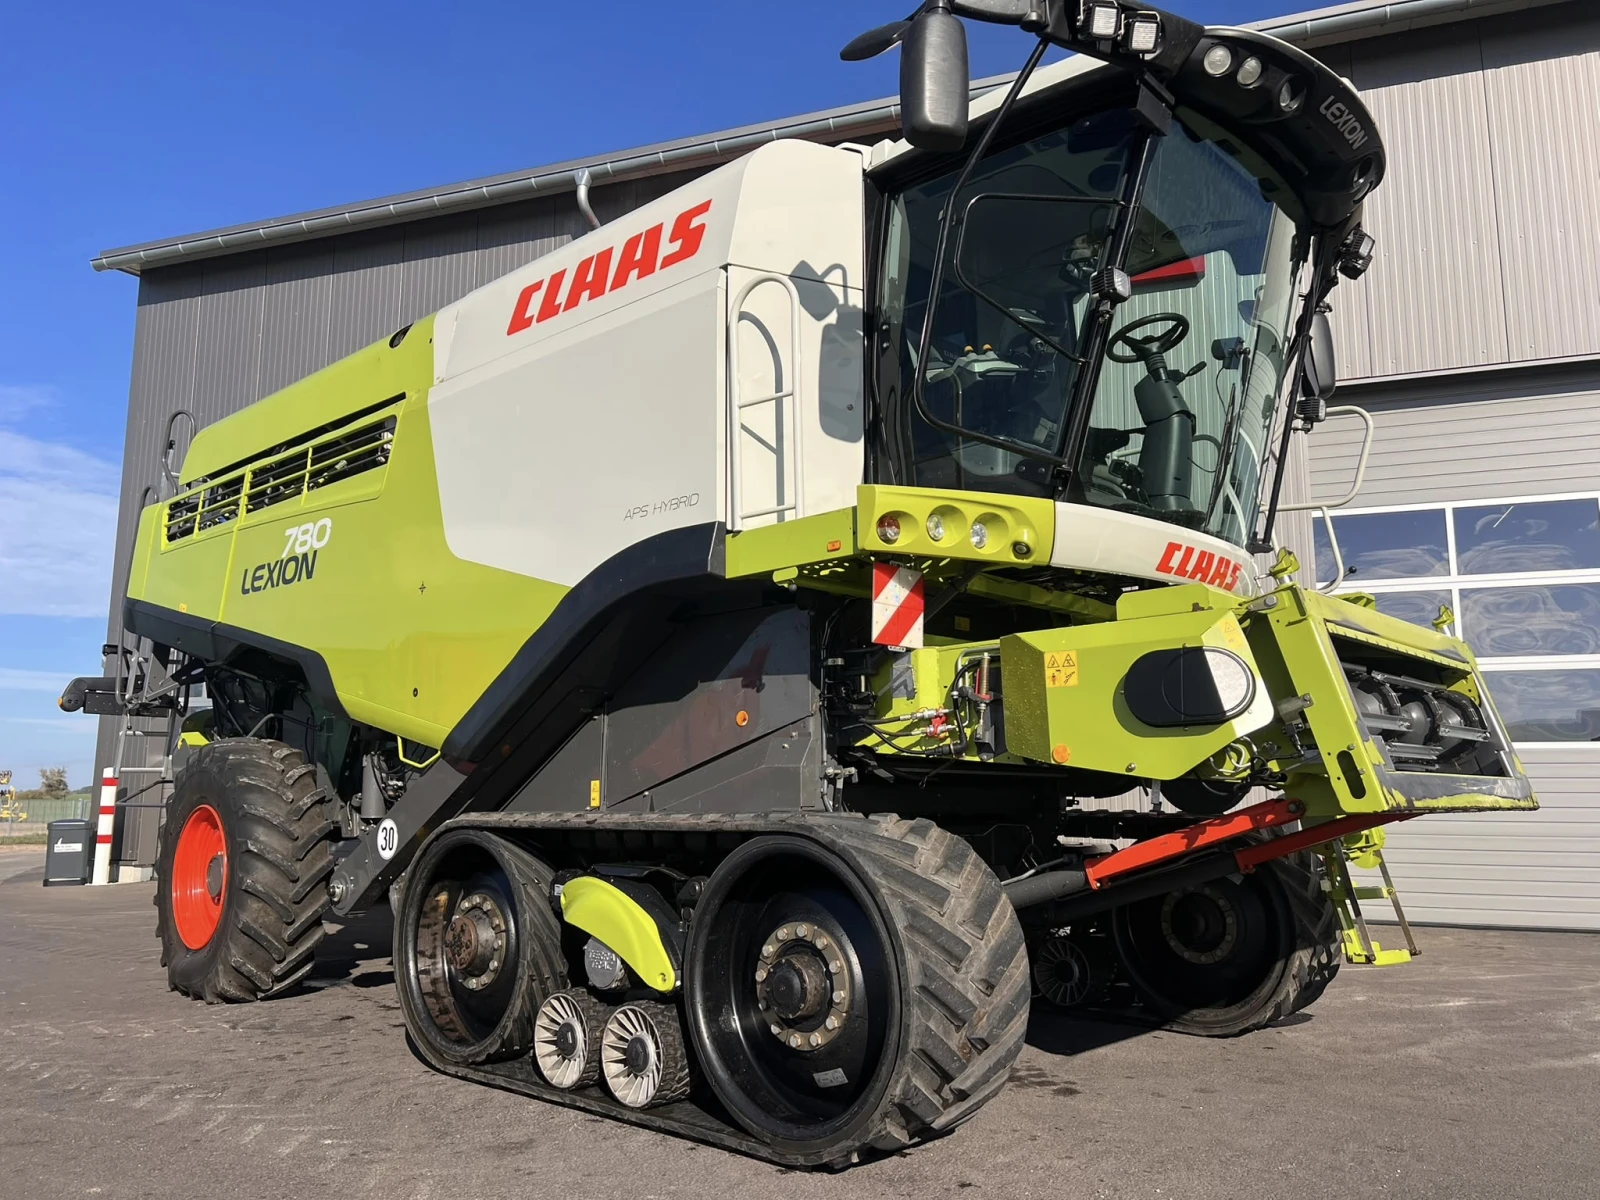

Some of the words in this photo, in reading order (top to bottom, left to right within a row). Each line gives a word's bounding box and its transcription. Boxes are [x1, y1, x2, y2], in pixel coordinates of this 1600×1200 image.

[1319, 95, 1368, 150] LEXION
[506, 198, 713, 336] CLAAS
[623, 504, 649, 521] APS
[652, 493, 700, 515] HYBRID
[281, 517, 332, 558] 780
[241, 549, 318, 595] LEXION
[1155, 541, 1243, 592] CLAAS
[380, 826, 395, 851] 30
